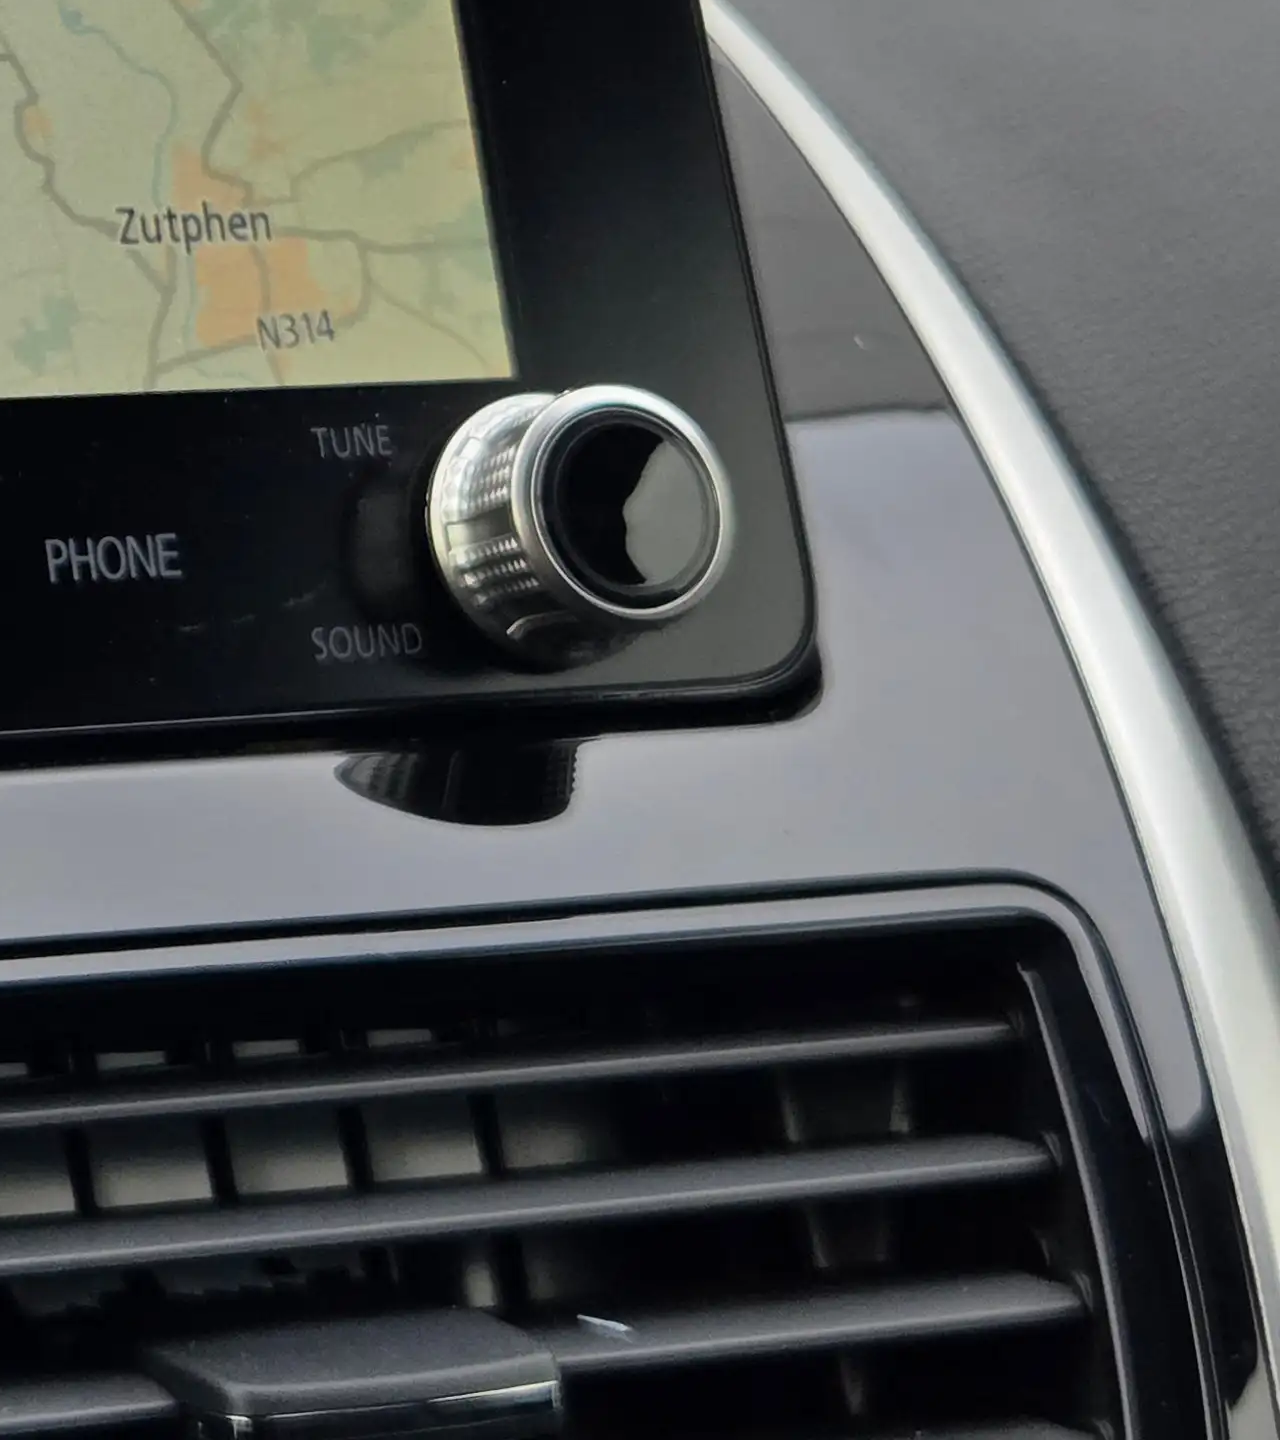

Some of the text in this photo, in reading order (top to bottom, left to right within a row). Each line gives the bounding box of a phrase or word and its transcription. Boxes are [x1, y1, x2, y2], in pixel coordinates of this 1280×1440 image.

[115, 202, 272, 254] Zutphen
[256, 310, 336, 350] N314
[310, 424, 394, 458] TUNE
[44, 534, 183, 584] PHONE
[310, 623, 424, 662] SOUND
